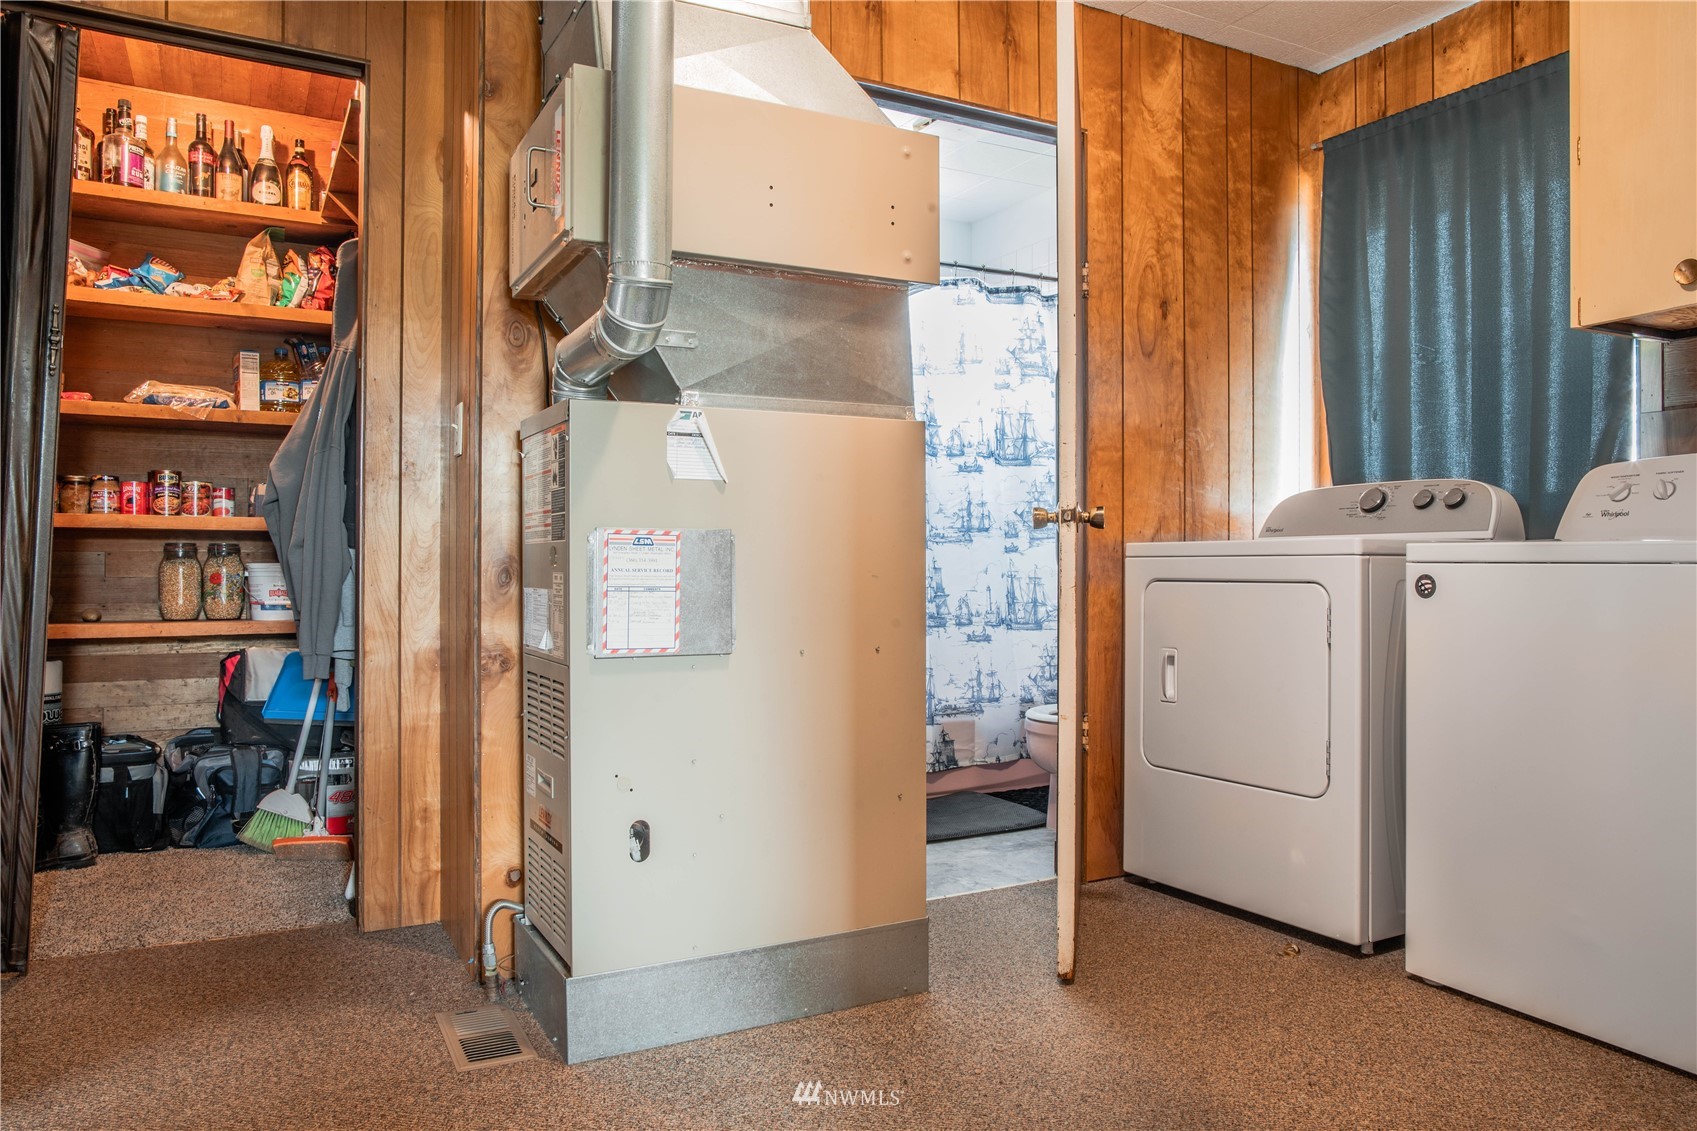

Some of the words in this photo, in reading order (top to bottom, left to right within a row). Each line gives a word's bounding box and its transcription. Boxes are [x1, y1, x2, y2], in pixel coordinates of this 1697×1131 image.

[158, 474, 179, 482] BUH'S
[1600, 509, 1630, 519] Whirlpool
[328, 790, 354, 805] 48
